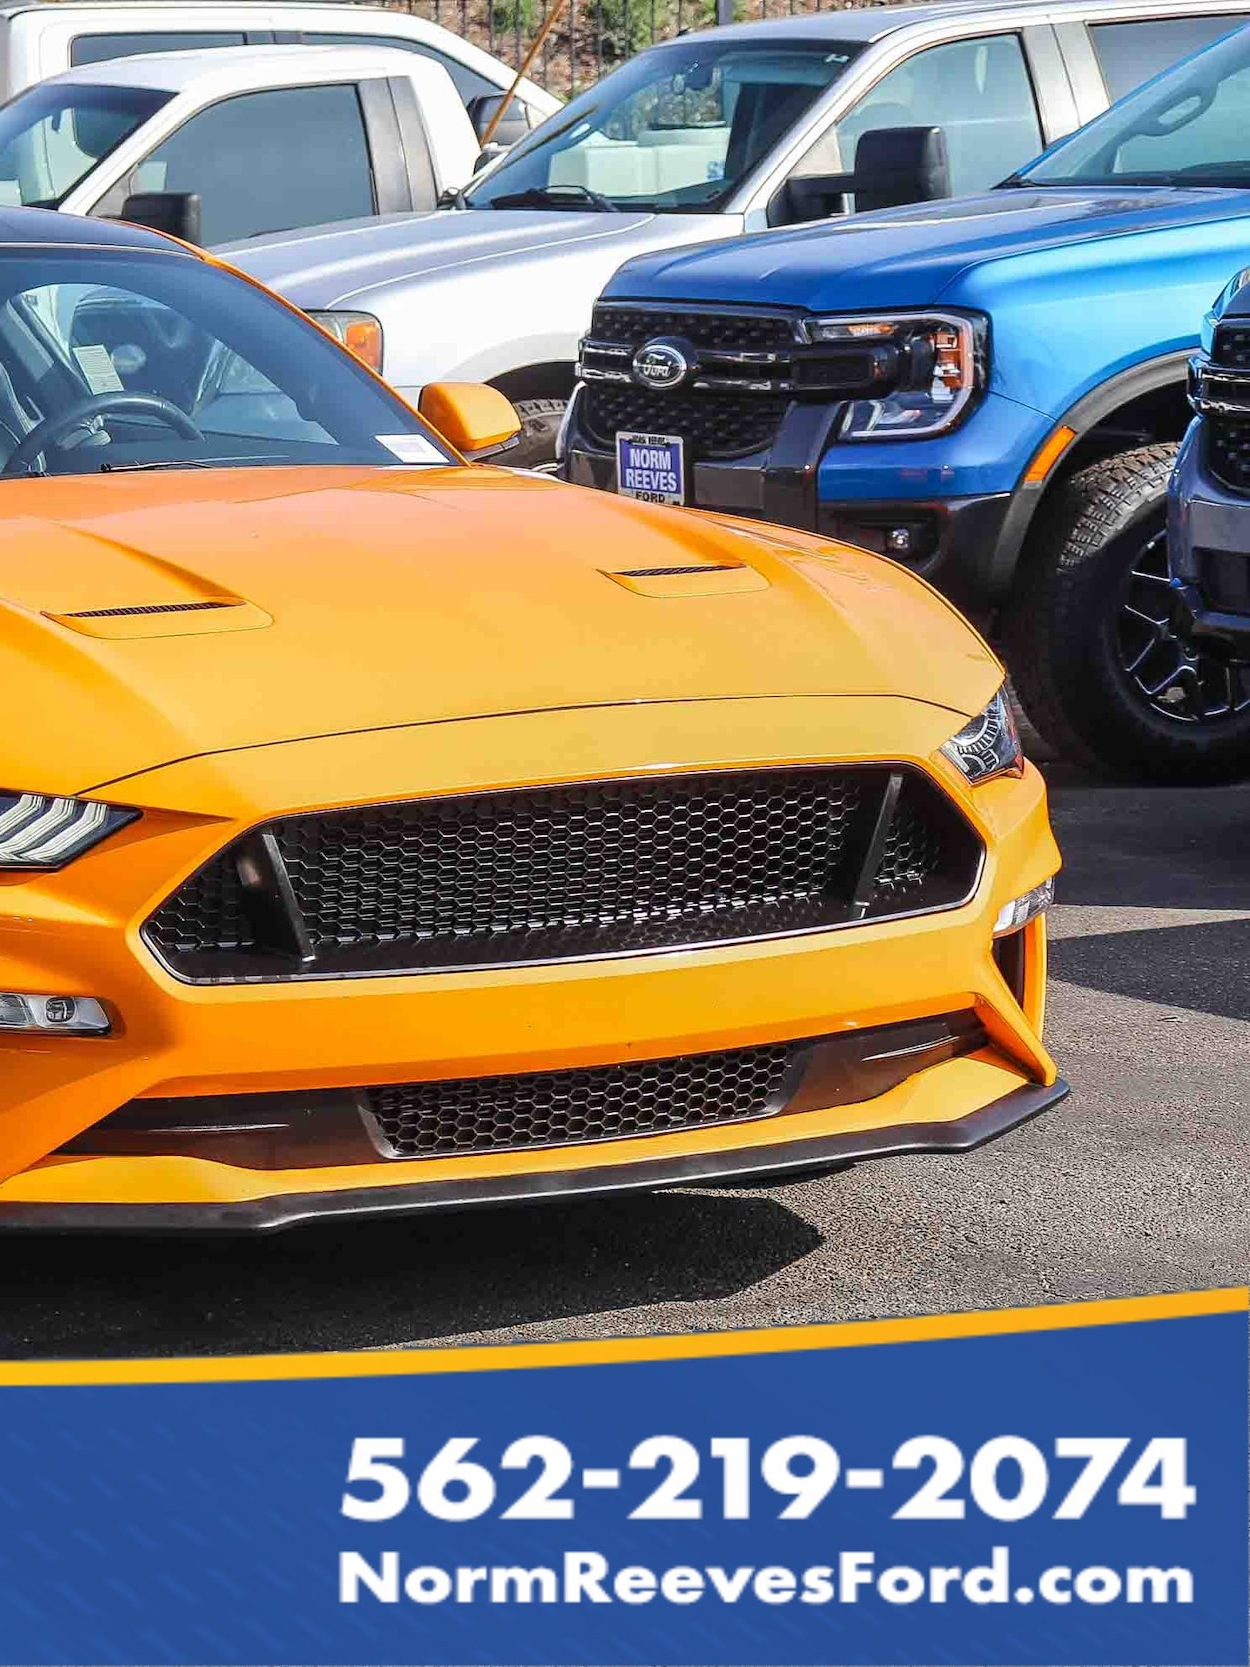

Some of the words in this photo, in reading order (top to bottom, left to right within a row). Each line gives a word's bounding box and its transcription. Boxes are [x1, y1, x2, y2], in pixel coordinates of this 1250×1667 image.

[643, 353, 672, 377] Ford
[629, 448, 671, 470] NORM
[626, 468, 677, 491] REEVES
[636, 491, 665, 503] FORD
